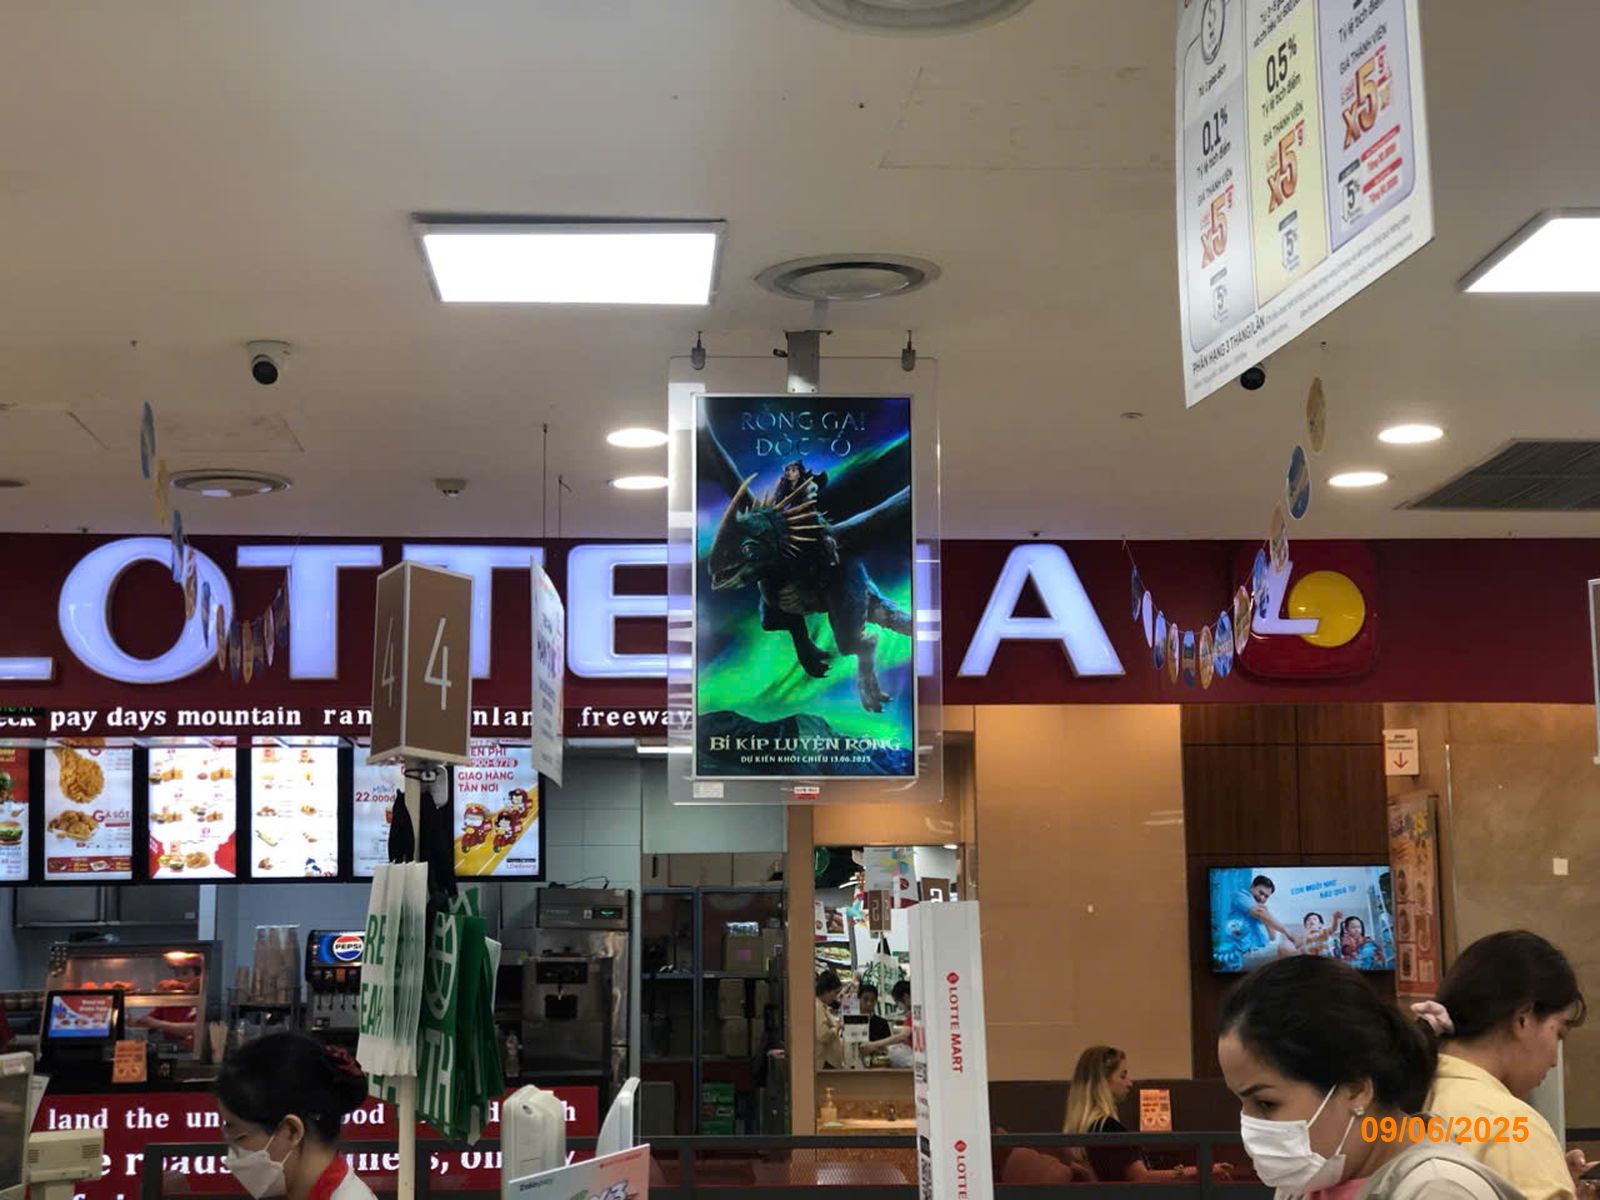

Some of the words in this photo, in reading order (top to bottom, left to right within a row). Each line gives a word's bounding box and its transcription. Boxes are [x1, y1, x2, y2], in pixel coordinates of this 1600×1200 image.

[1266, 35, 1297, 93] 0.5%
[1202, 106, 1229, 157] 0.1%
[424, 617, 452, 710] 4
[51, 710, 97, 731] pay
[107, 706, 166, 731] days
[178, 706, 301, 726] mountain
[324, 709, 372, 725] ran
[458, 771, 483, 781] GIAO
[335, 942, 362, 950] PEPSI
[948, 988, 960, 1028] LOTTE
[950, 1033, 964, 1073] MART
[48, 1108, 108, 1129] land
[126, 1107, 169, 1128] the
